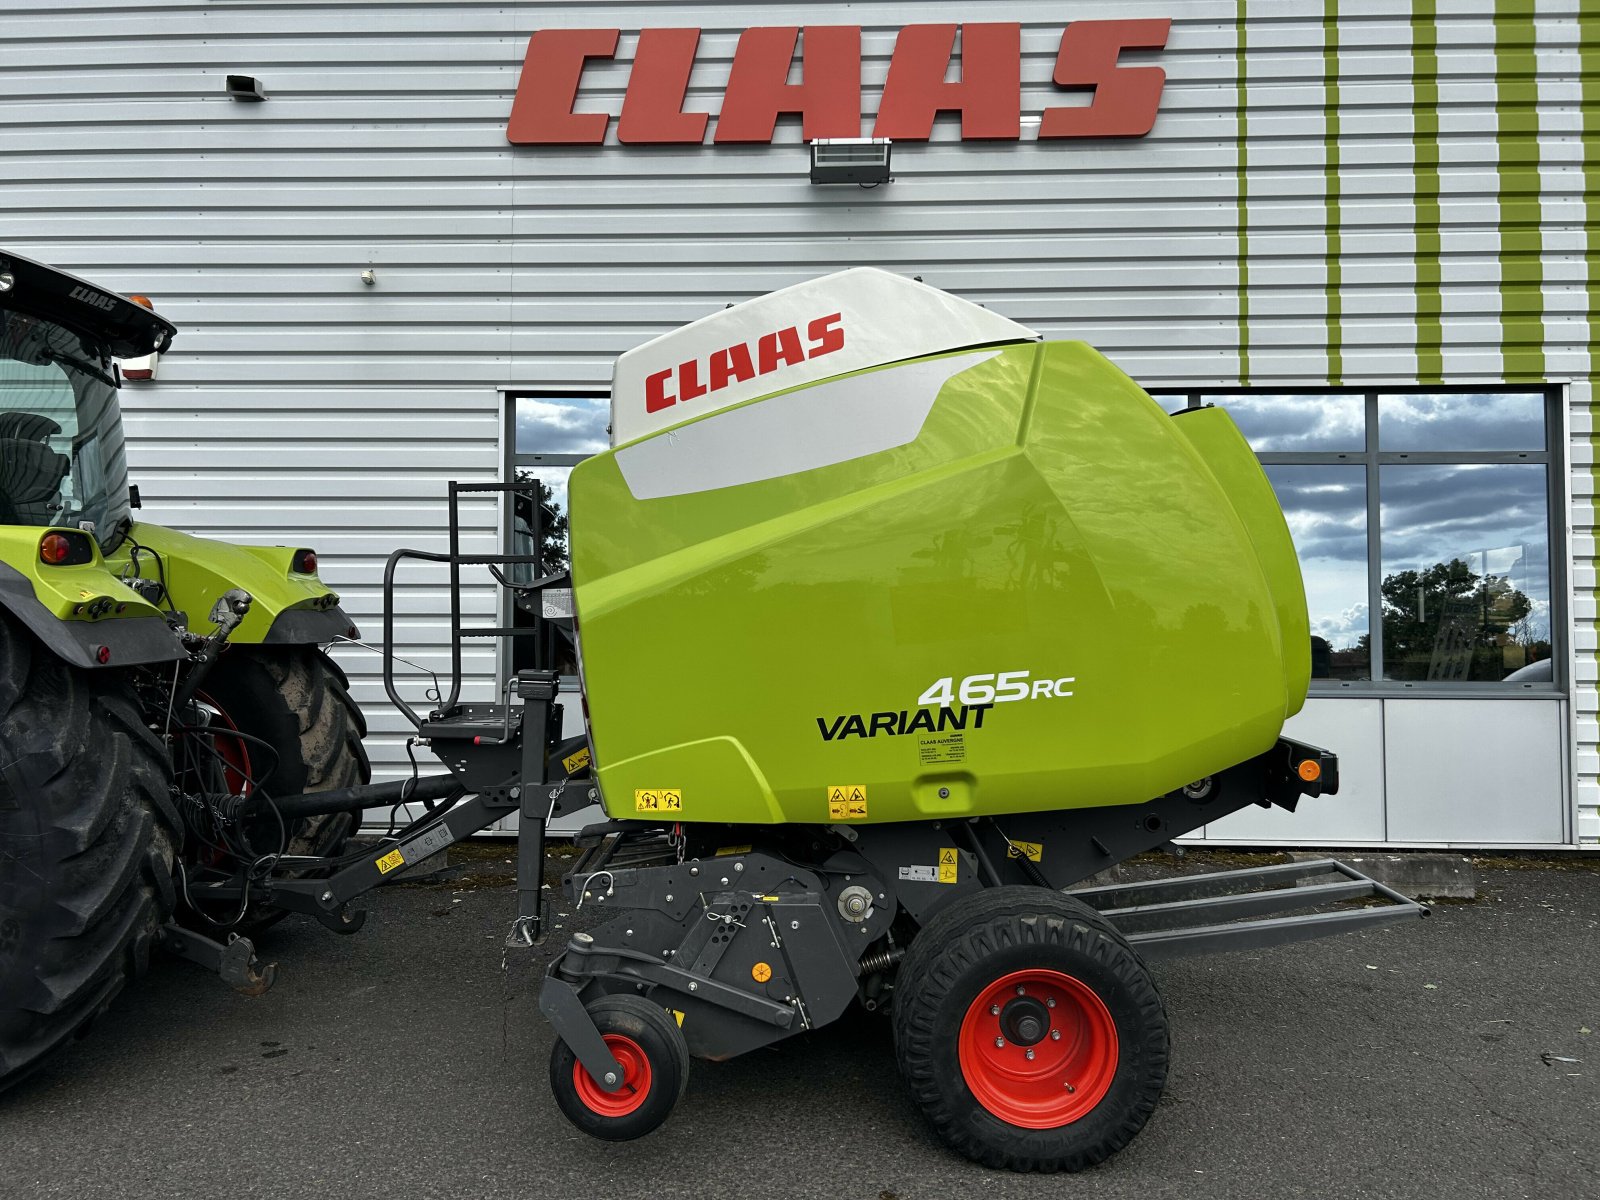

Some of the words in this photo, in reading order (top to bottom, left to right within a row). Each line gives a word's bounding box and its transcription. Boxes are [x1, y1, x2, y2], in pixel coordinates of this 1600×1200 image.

[506, 18, 1172, 146] CLAAS
[68, 285, 118, 312] CLAAS
[645, 312, 845, 414] CLAAS
[816, 703, 994, 742] VARIANT
